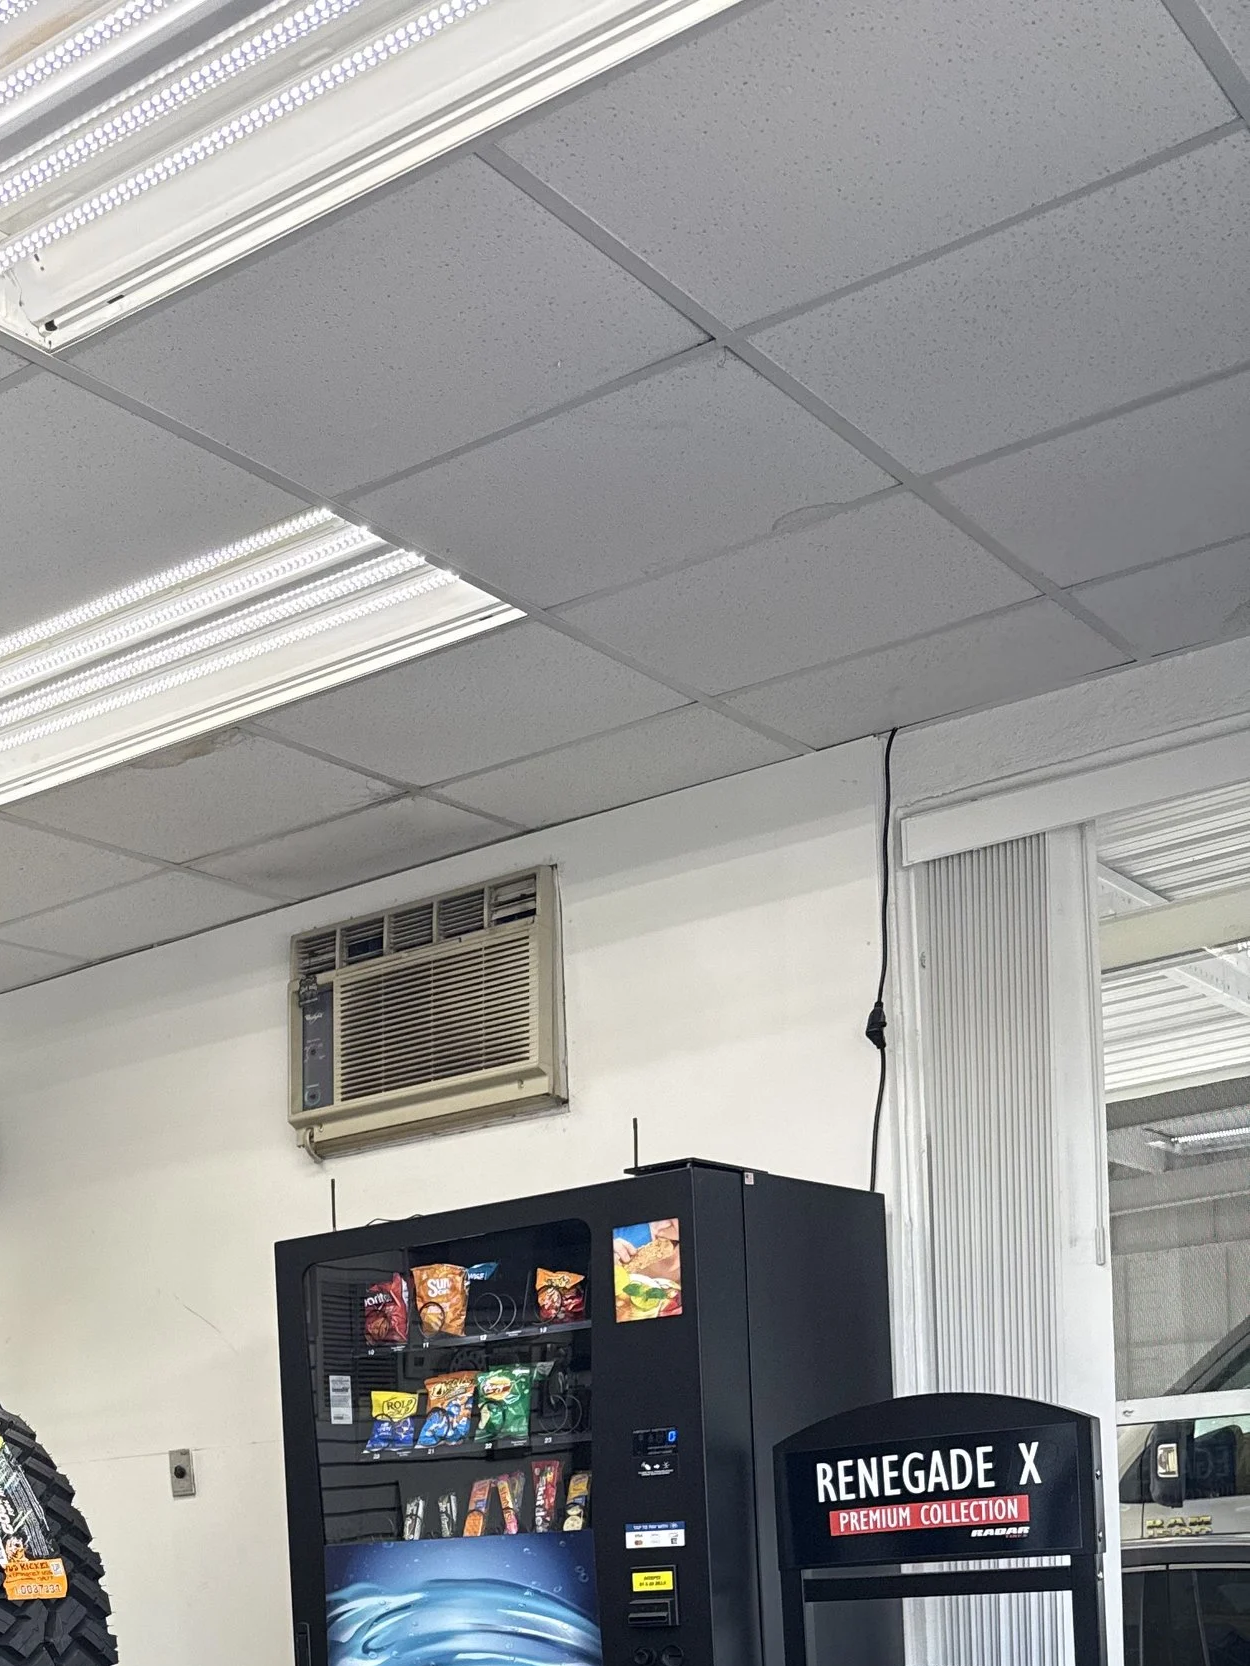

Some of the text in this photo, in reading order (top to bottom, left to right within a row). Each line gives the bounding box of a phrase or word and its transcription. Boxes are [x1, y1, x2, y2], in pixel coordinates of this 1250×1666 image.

[816, 1441, 1043, 1503] RENEGADE X
[839, 1498, 1019, 1533] PREMIUM COLLECTION
[970, 1526, 1030, 1538] RADAR
